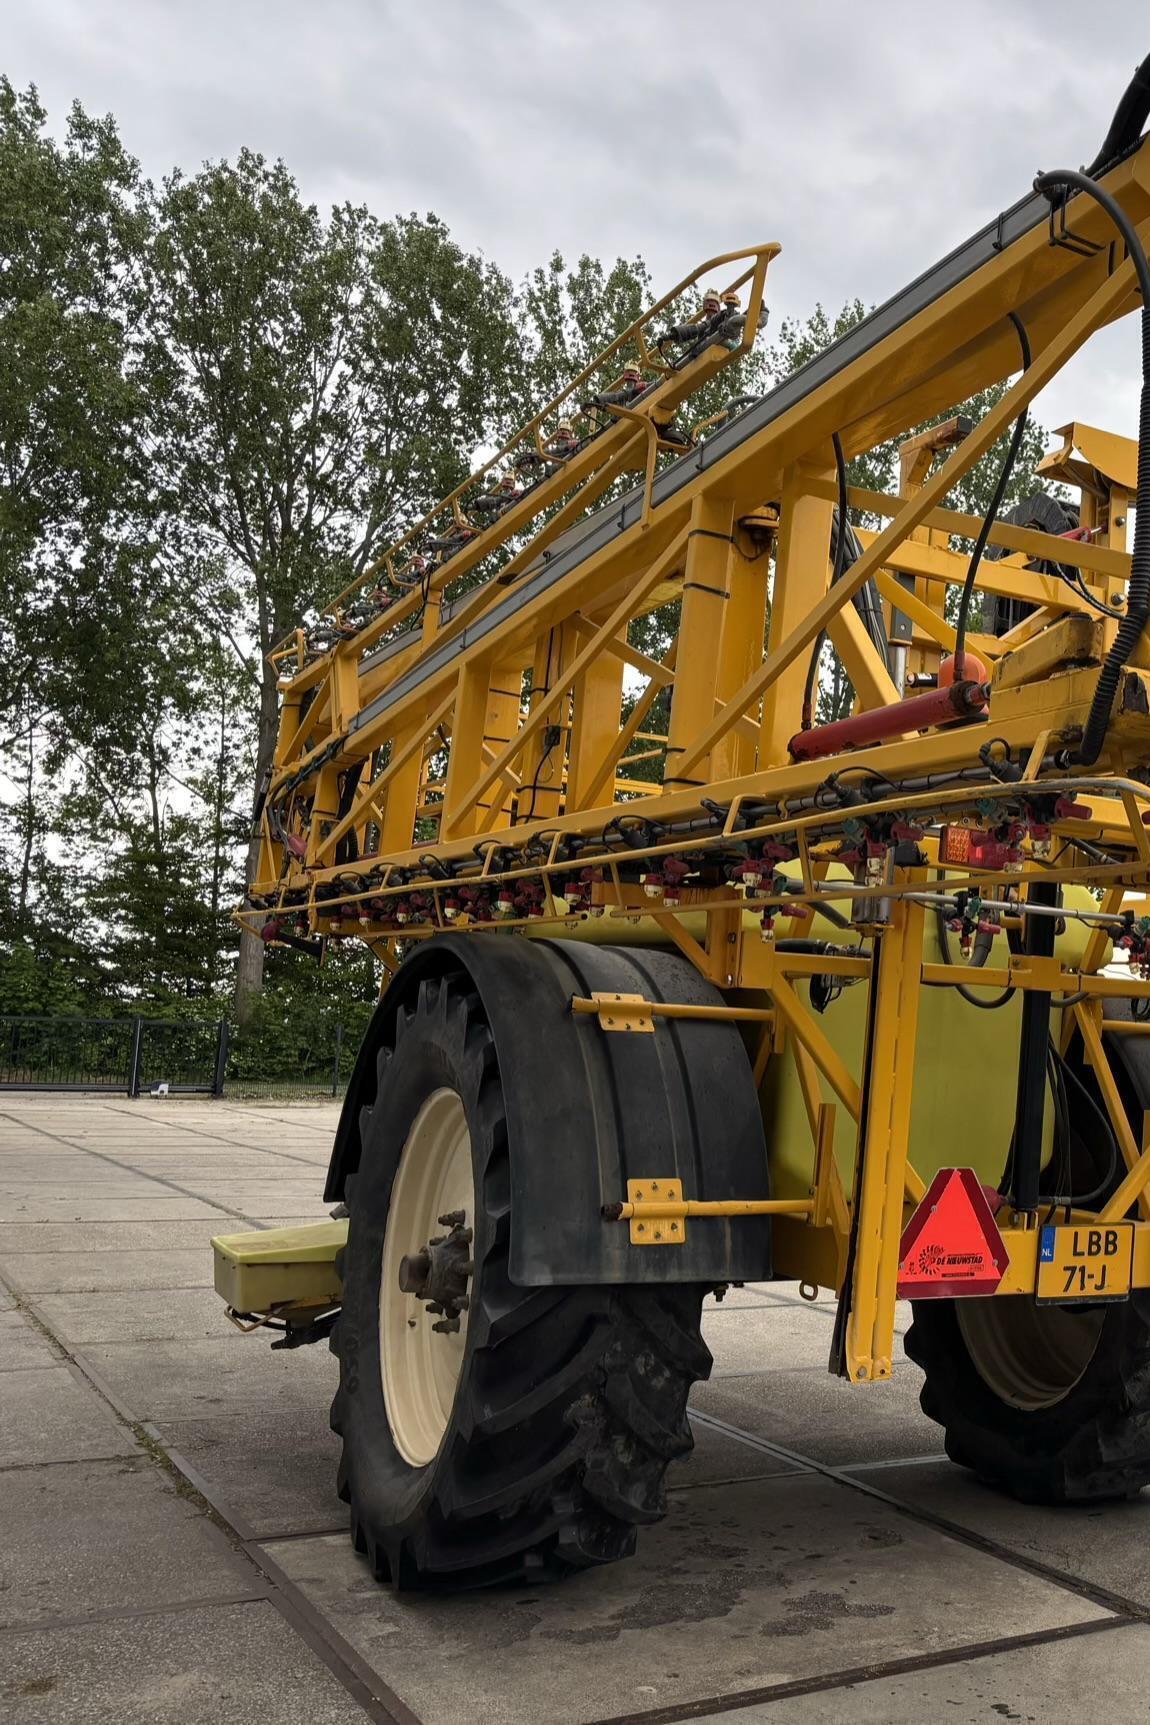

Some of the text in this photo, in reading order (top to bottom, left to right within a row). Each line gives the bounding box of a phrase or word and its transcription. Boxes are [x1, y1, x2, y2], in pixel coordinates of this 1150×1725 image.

[1073, 1230, 1118, 1256] LBB
[936, 1256, 983, 1265] DE NIEUWSTAD
[1042, 1249, 1052, 1257] NL
[1063, 1264, 1107, 1293] 71-J
